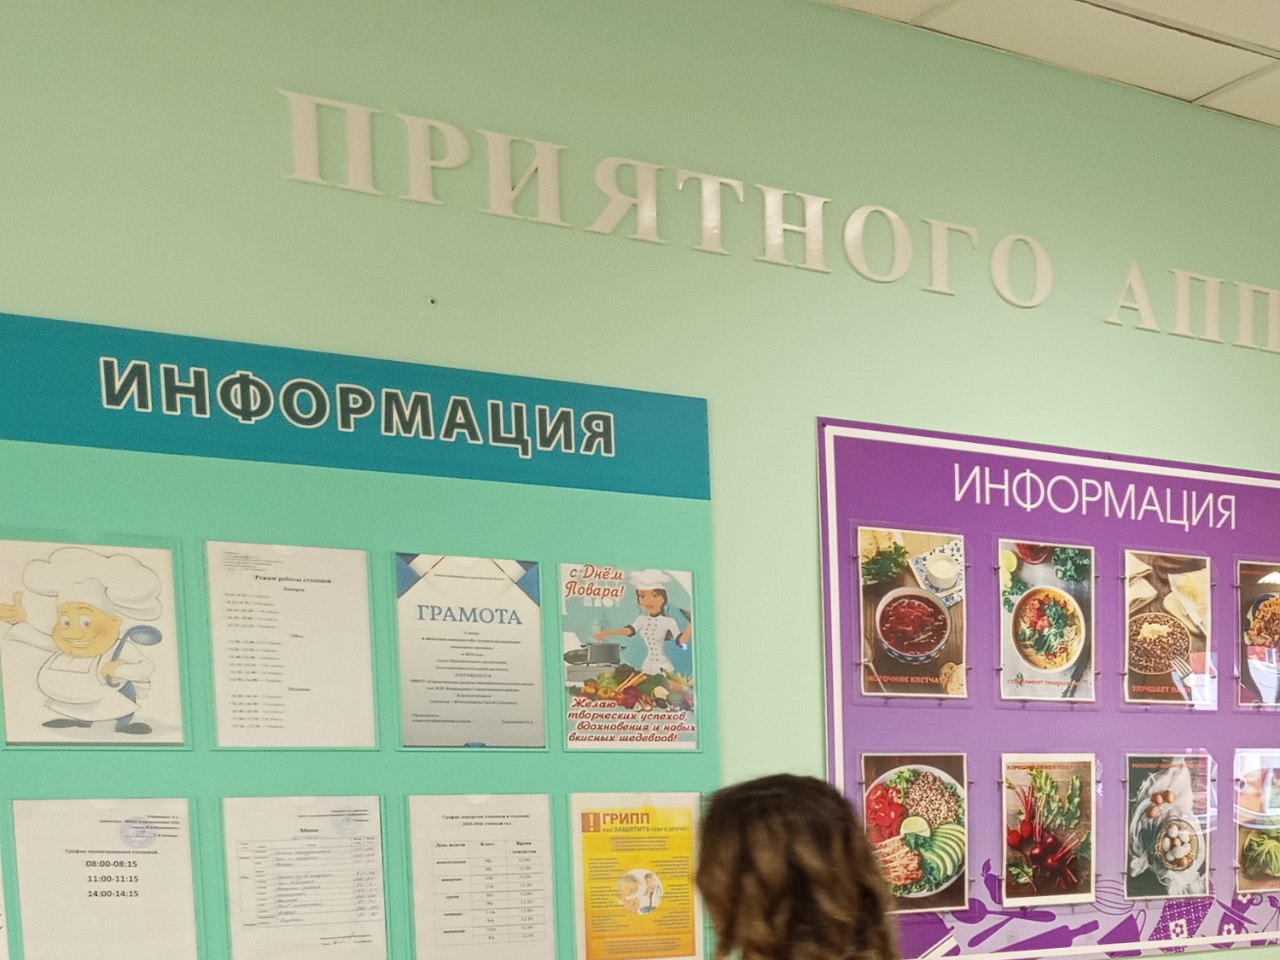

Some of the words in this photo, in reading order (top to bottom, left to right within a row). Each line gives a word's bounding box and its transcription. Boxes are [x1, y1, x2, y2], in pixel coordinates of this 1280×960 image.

[278, 89, 1053, 308] ПРИЯТНОГО
[98, 356, 616, 459] ИНФОРМАЦИЯ
[953, 463, 1237, 533] ИНФОРМАЦИЯ
[582, 564, 624, 581] Днём
[564, 581, 625, 598] Повара!
[416, 604, 523, 625] ГРАМОТА
[571, 698, 617, 709] Желаю
[567, 710, 638, 722] творческих
[576, 720, 649, 732] вдохновения
[663, 722, 695, 732] новых
[602, 812, 650, 825] ГРИПП
[85, 860, 138, 868] 08:00-08:15
[87, 875, 139, 883] 11:00-11:15
[87, 890, 139, 898] 14:00-14:15
